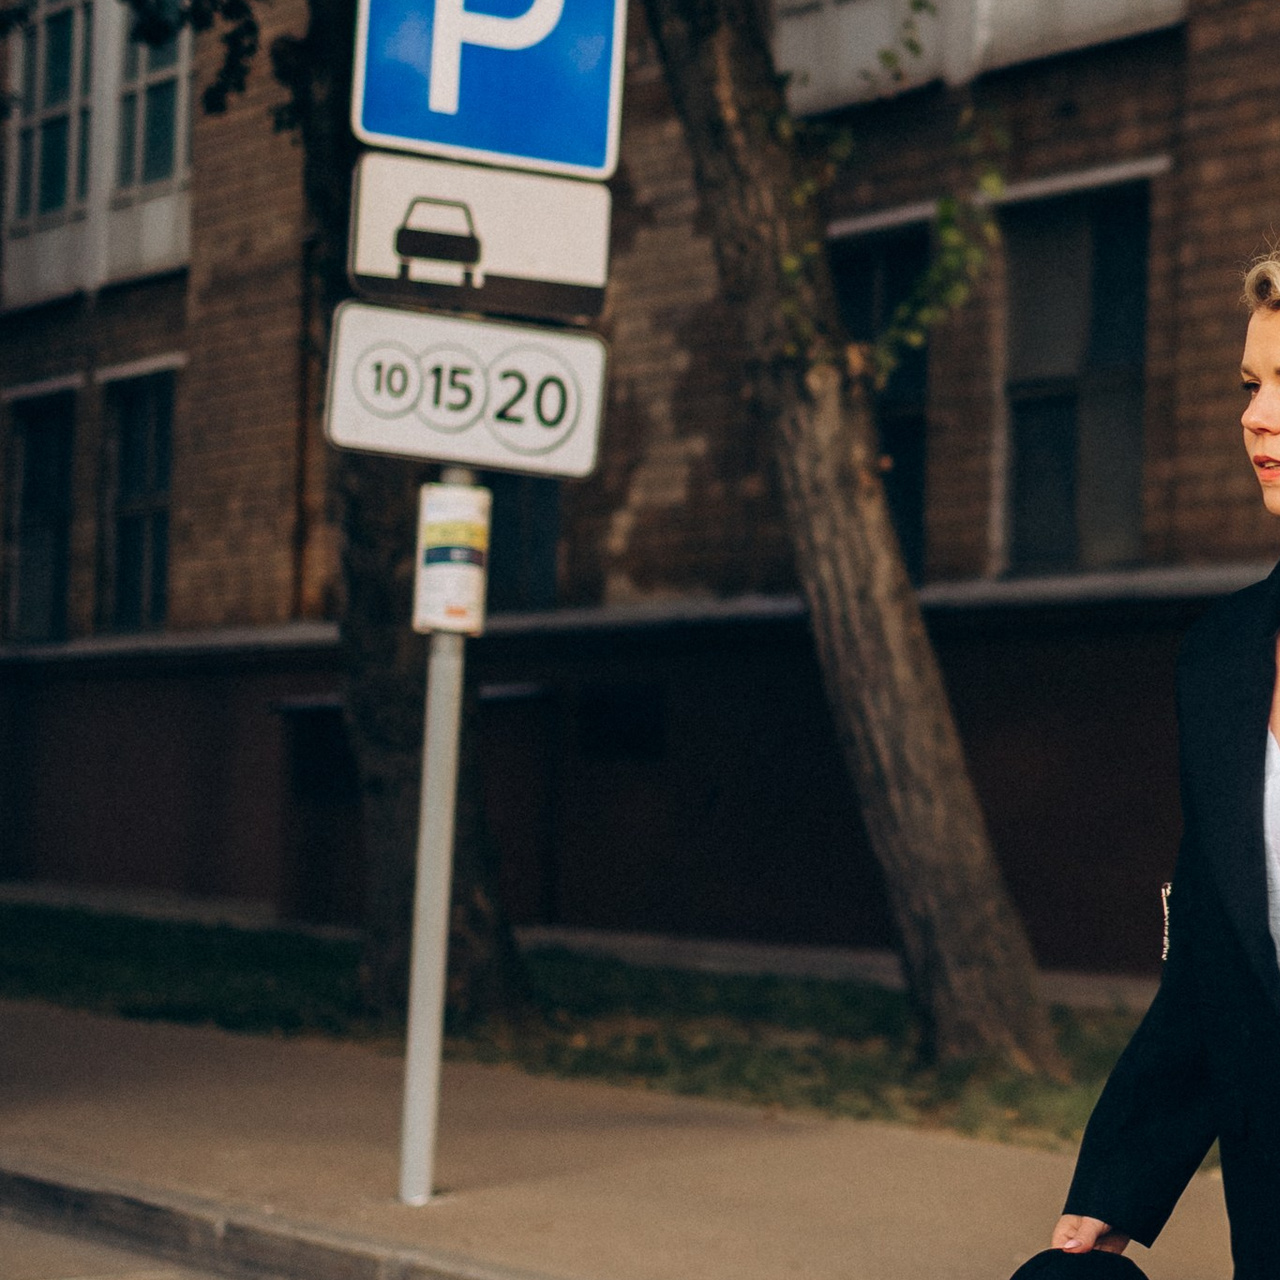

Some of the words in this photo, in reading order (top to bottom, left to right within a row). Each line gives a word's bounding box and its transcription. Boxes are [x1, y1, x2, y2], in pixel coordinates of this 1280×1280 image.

[373, 362, 409, 398] 10
[430, 365, 473, 411] 15
[495, 369, 568, 427] 20
